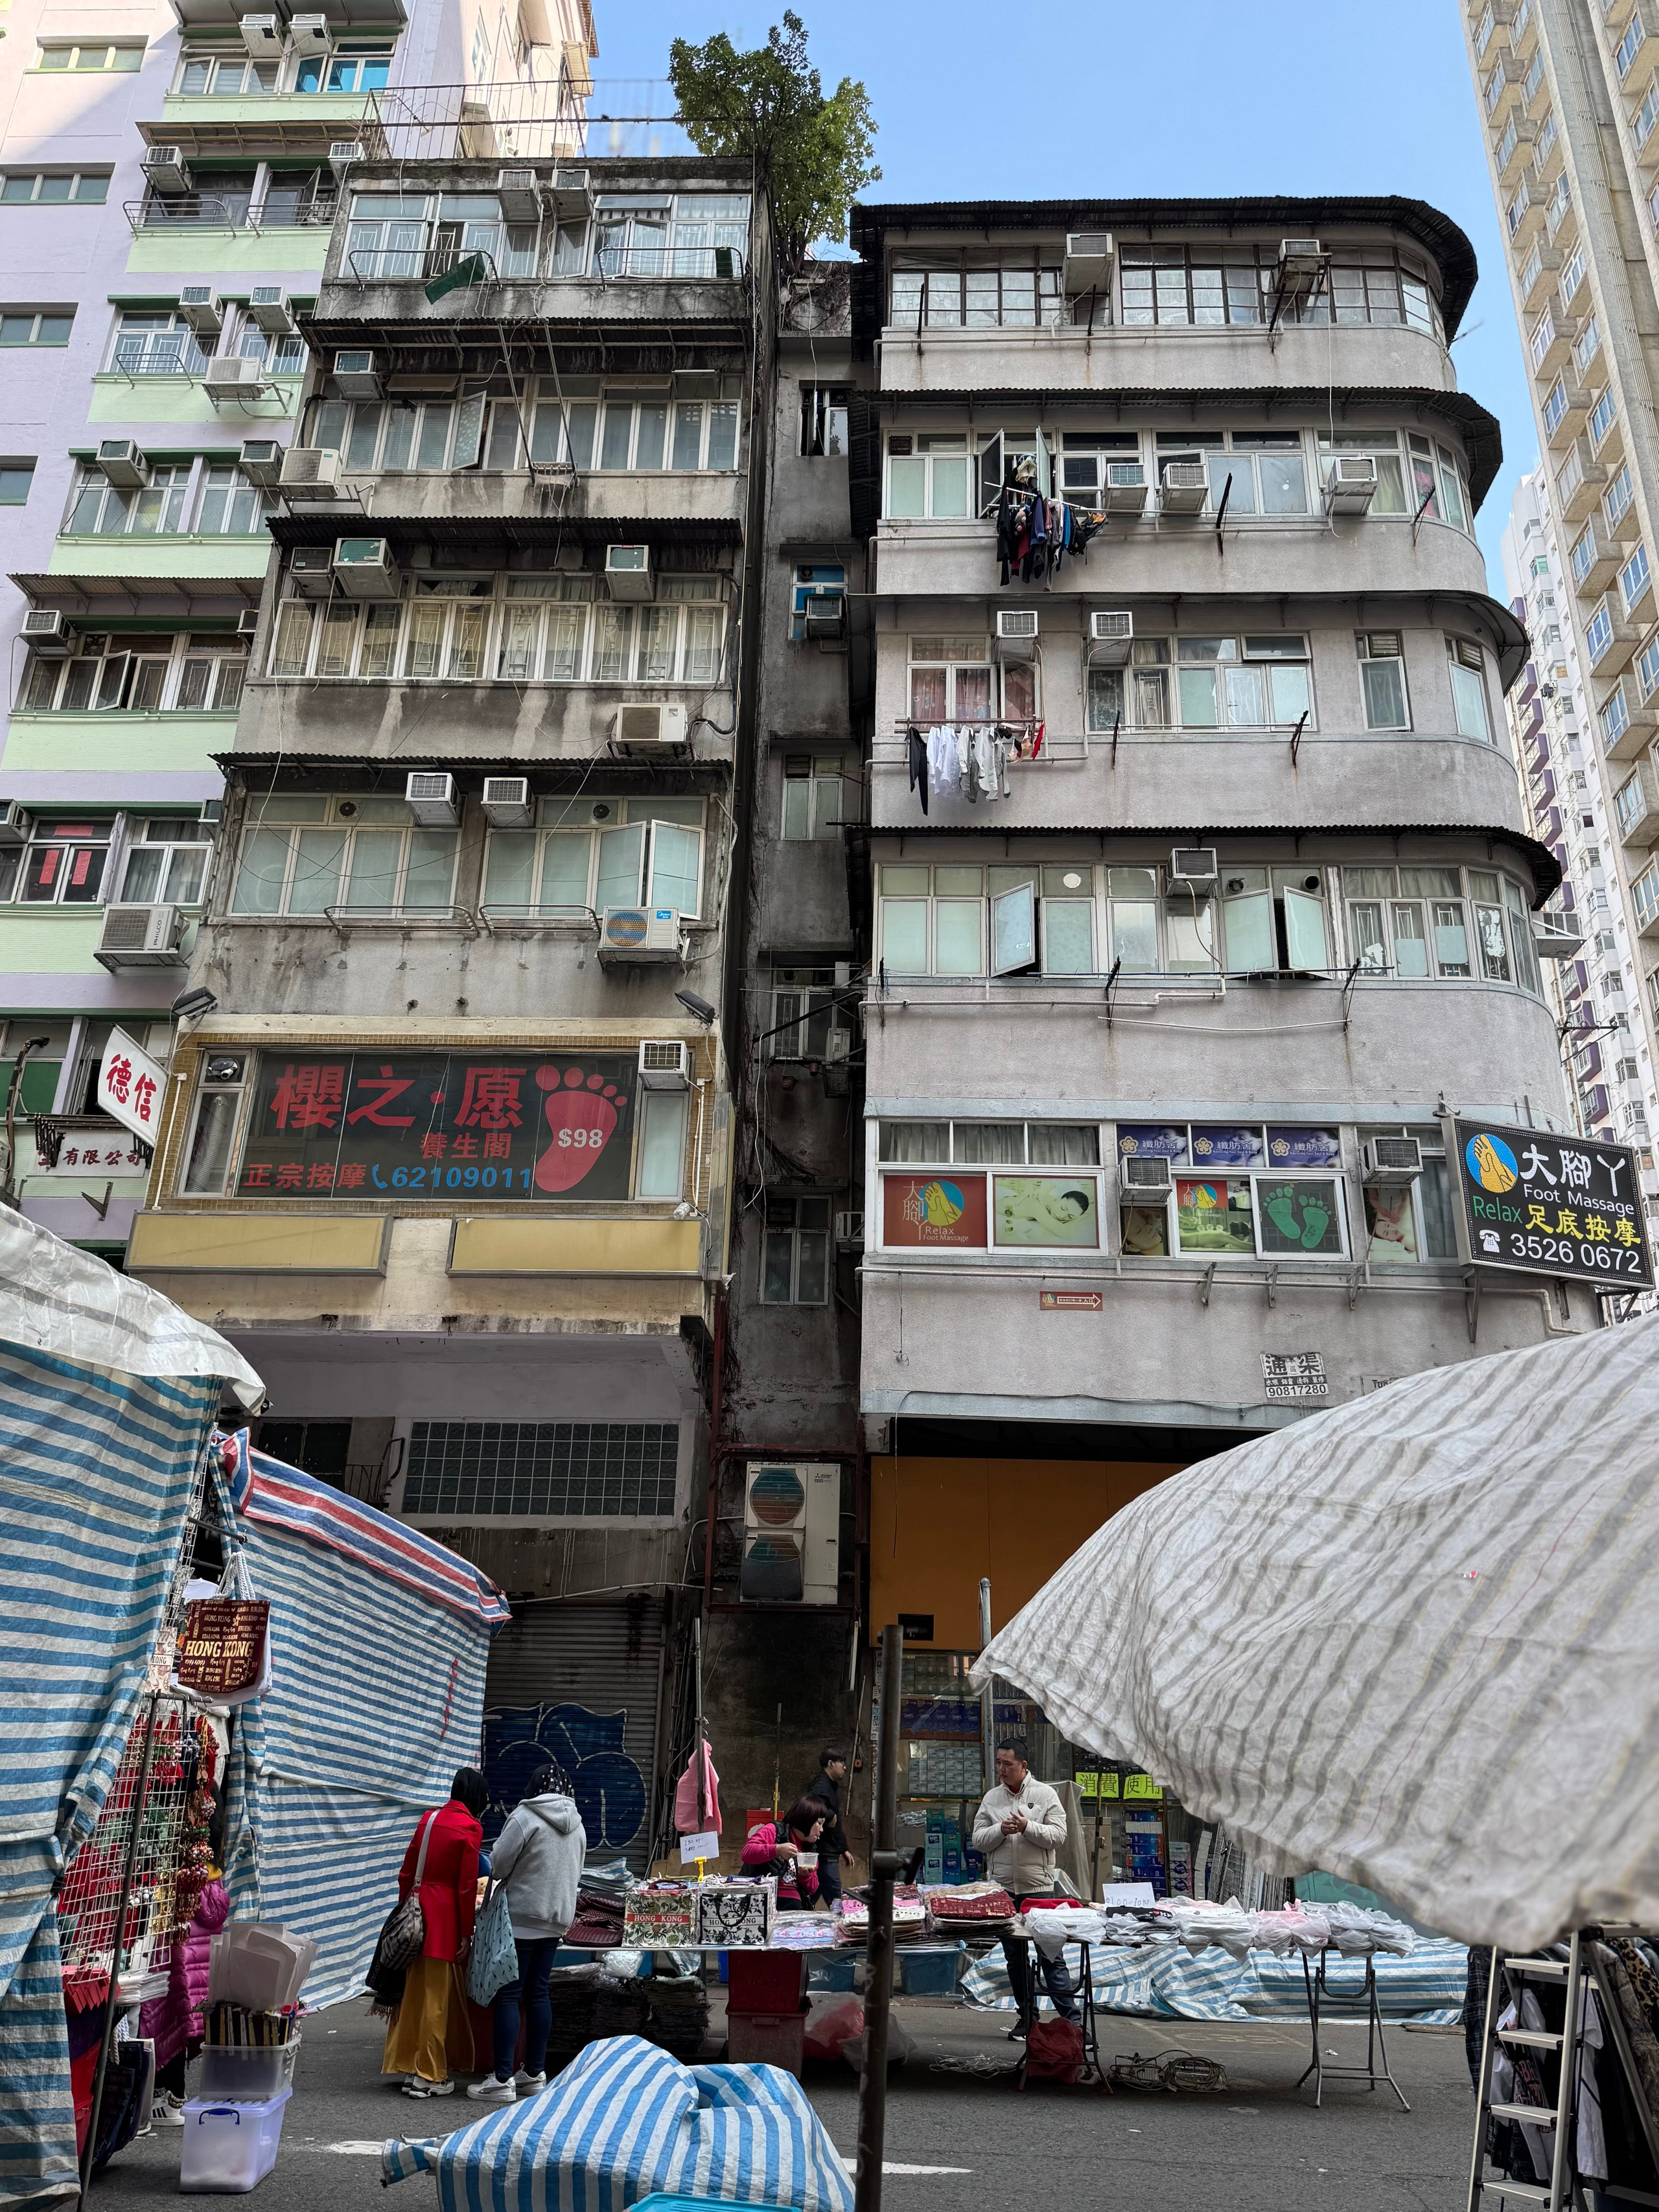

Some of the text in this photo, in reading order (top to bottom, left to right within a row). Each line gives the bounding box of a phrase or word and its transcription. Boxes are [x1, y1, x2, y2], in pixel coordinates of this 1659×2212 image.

[153, 920, 162, 946] PHILCO
[106, 1053, 157, 1123] 德信
[419, 1132, 511, 1159] 養生閣
[558, 1128, 603, 1148] $98
[244, 1163, 366, 1189] 正宗按摩
[391, 1167, 531, 1189] 62109011
[1520, 1143, 1626, 1196] 大腳丫
[902, 1180, 928, 1240] 大腳丫
[1472, 1195, 1523, 1224] Relax
[1524, 1183, 1635, 1217] Foot Massage
[925, 1226, 955, 1235] Relax
[1525, 1204, 1642, 1247] 足底按摩
[1510, 1233, 1642, 1273] 3526 0672
[1265, 1353, 1320, 1377] 通渠
[1268, 1384, 1327, 1397] 90817280
[184, 1640, 255, 1657] HONG KONG
[1080, 1773, 1117, 1794] 消費
[1127, 1775, 1161, 1795] 使用
